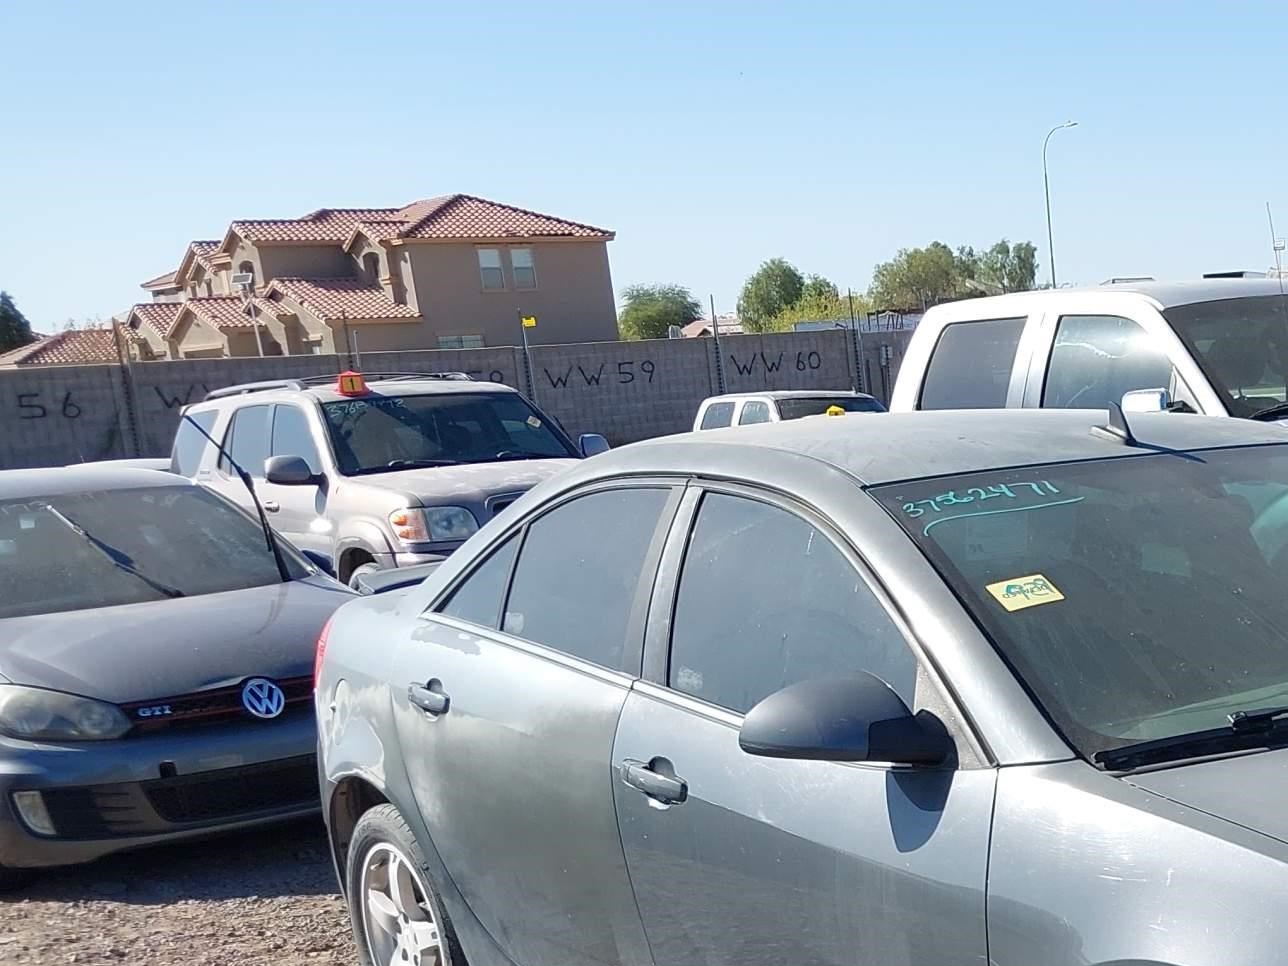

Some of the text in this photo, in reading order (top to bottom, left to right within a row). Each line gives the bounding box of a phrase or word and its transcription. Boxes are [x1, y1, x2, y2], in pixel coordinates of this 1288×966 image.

[617, 359, 656, 385] 59
[795, 350, 822, 372] 60
[902, 479, 1061, 518] 37562471
[137, 704, 173, 717] GTI
